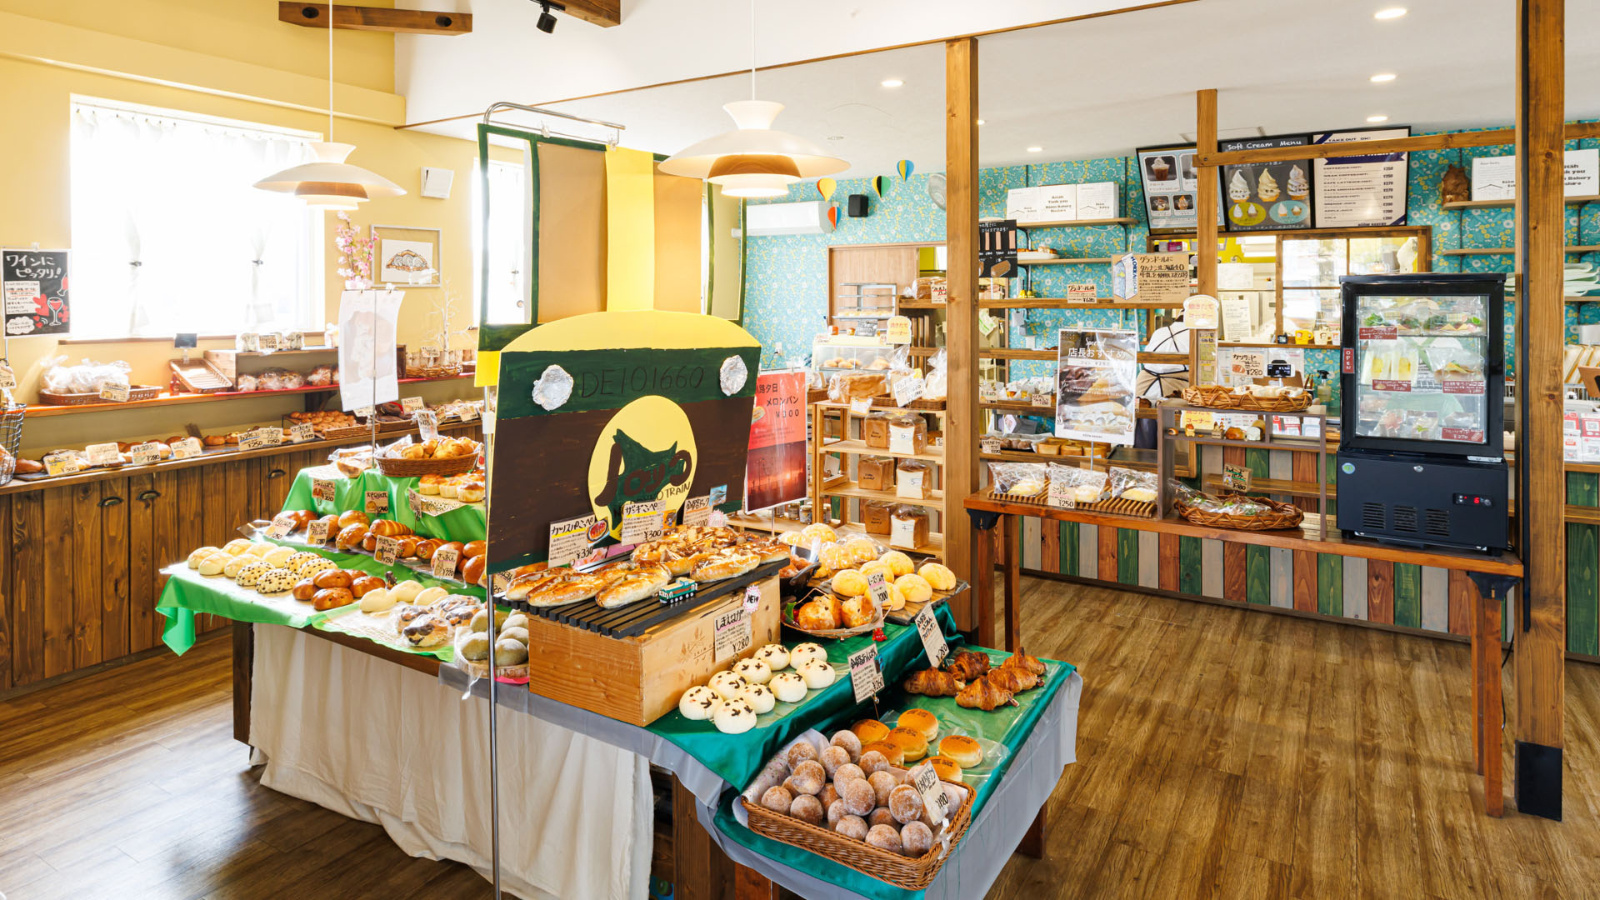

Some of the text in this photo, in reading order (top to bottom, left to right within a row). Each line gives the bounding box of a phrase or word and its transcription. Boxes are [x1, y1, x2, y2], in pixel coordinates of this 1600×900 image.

[1227, 142, 1243, 151] Soft
[1246, 141, 1273, 149] Cream
[6, 254, 55, 267] ワインに
[1245, 368, 1263, 376] ¥280
[581, 366, 705, 398] DE101660
[756, 383, 778, 394] 路夕日
[766, 395, 799, 407] メロンパン
[666, 482, 691, 498] TRAIN
[644, 529, 662, 539] ¥300
[732, 635, 750, 653] ¥280
